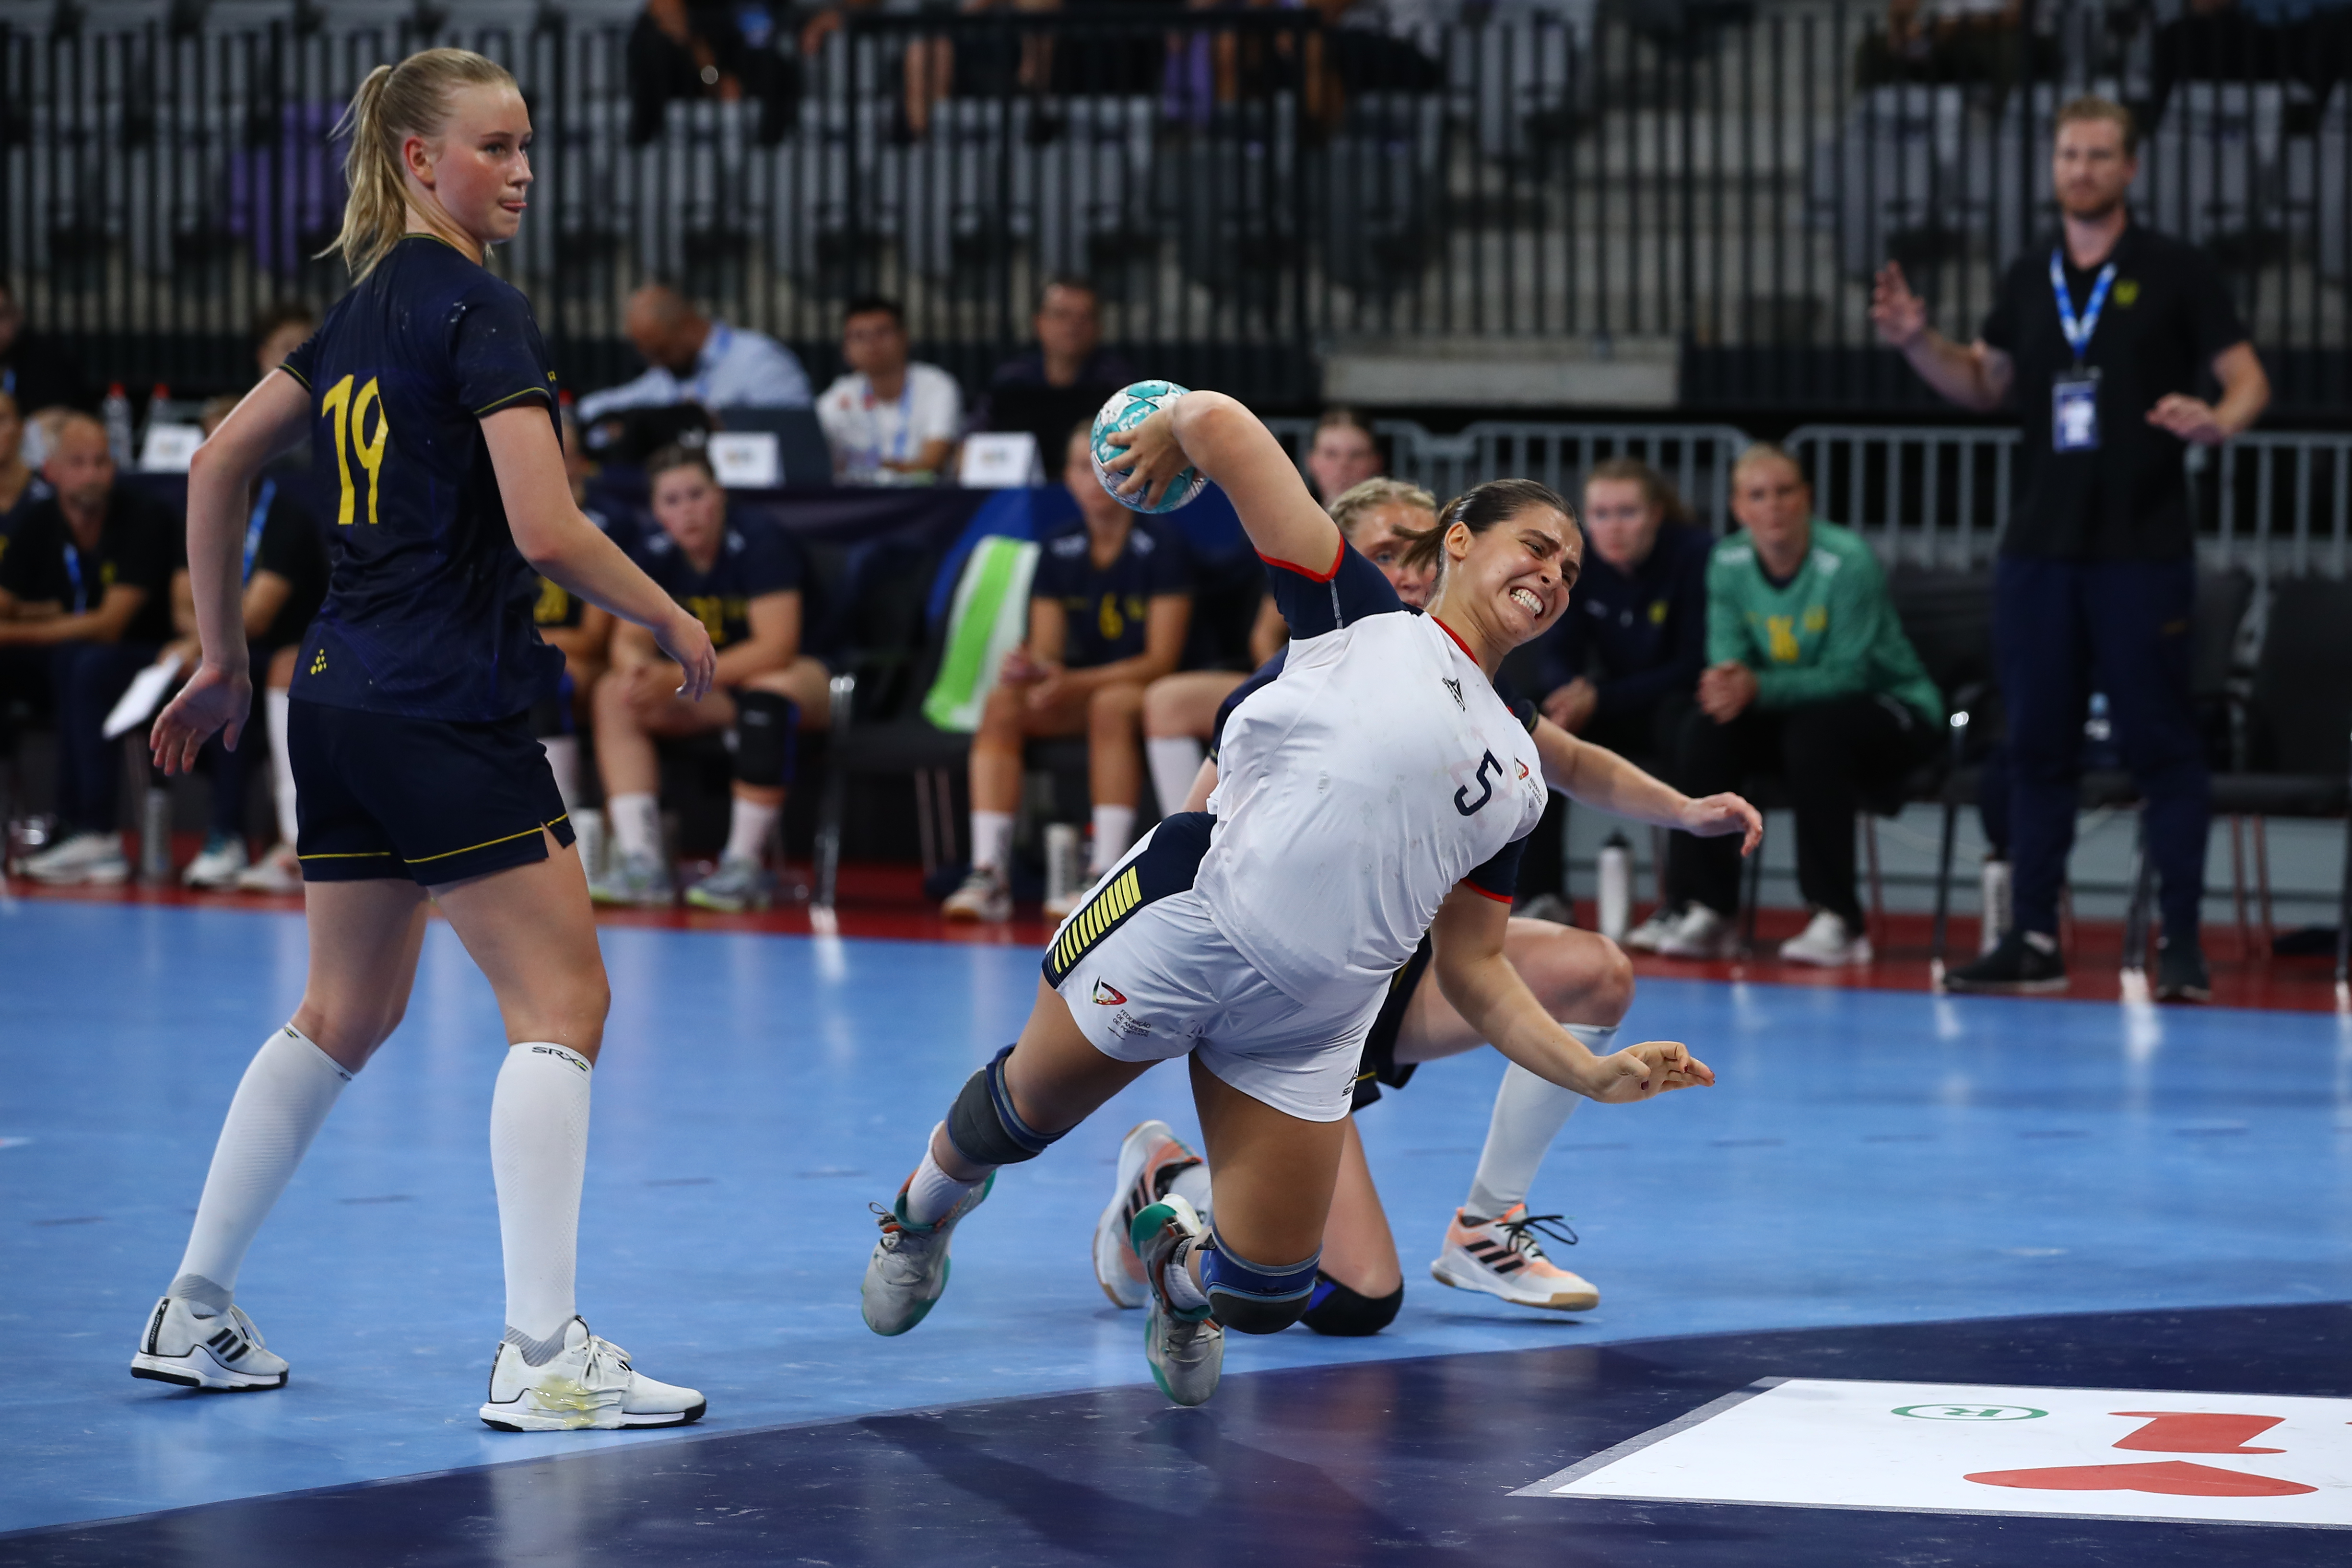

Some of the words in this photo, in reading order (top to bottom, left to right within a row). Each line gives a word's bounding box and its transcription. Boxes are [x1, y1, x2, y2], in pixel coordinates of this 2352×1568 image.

[322, 374, 389, 525] 19
[1099, 593, 1123, 640] 6
[1454, 748, 1503, 816] 5
[1116, 1014, 1124, 1022] DE
